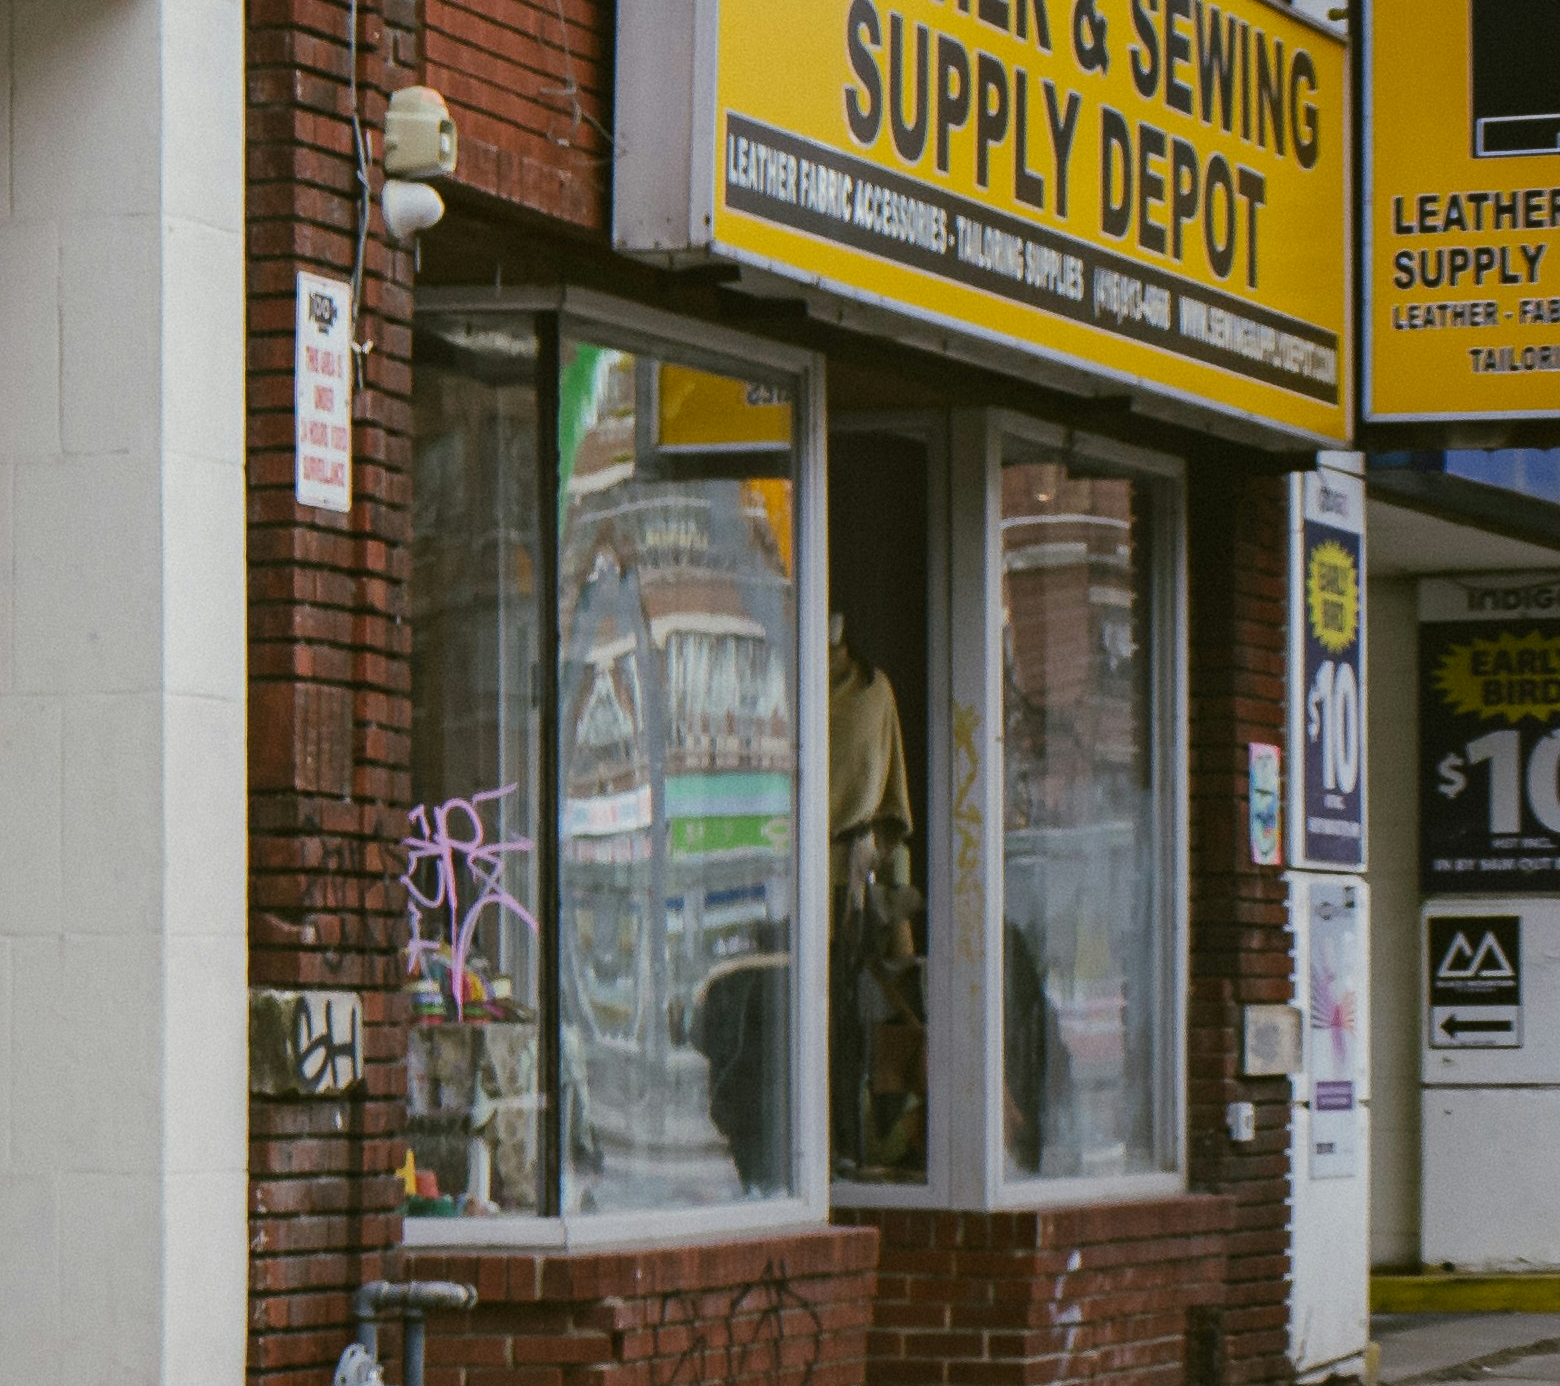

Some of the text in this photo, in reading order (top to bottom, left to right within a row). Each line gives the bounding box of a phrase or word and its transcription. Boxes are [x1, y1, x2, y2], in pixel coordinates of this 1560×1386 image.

[727, 132, 798, 205] LEATHER
[798, 158, 854, 223] FABRIC
[1097, 103, 1266, 293] DEPOT
[1392, 243, 1548, 290] SUPPLY
[1392, 299, 1500, 330] LEATHER
[1471, 648, 1560, 677] EARL
[1309, 660, 1358, 794] $10
